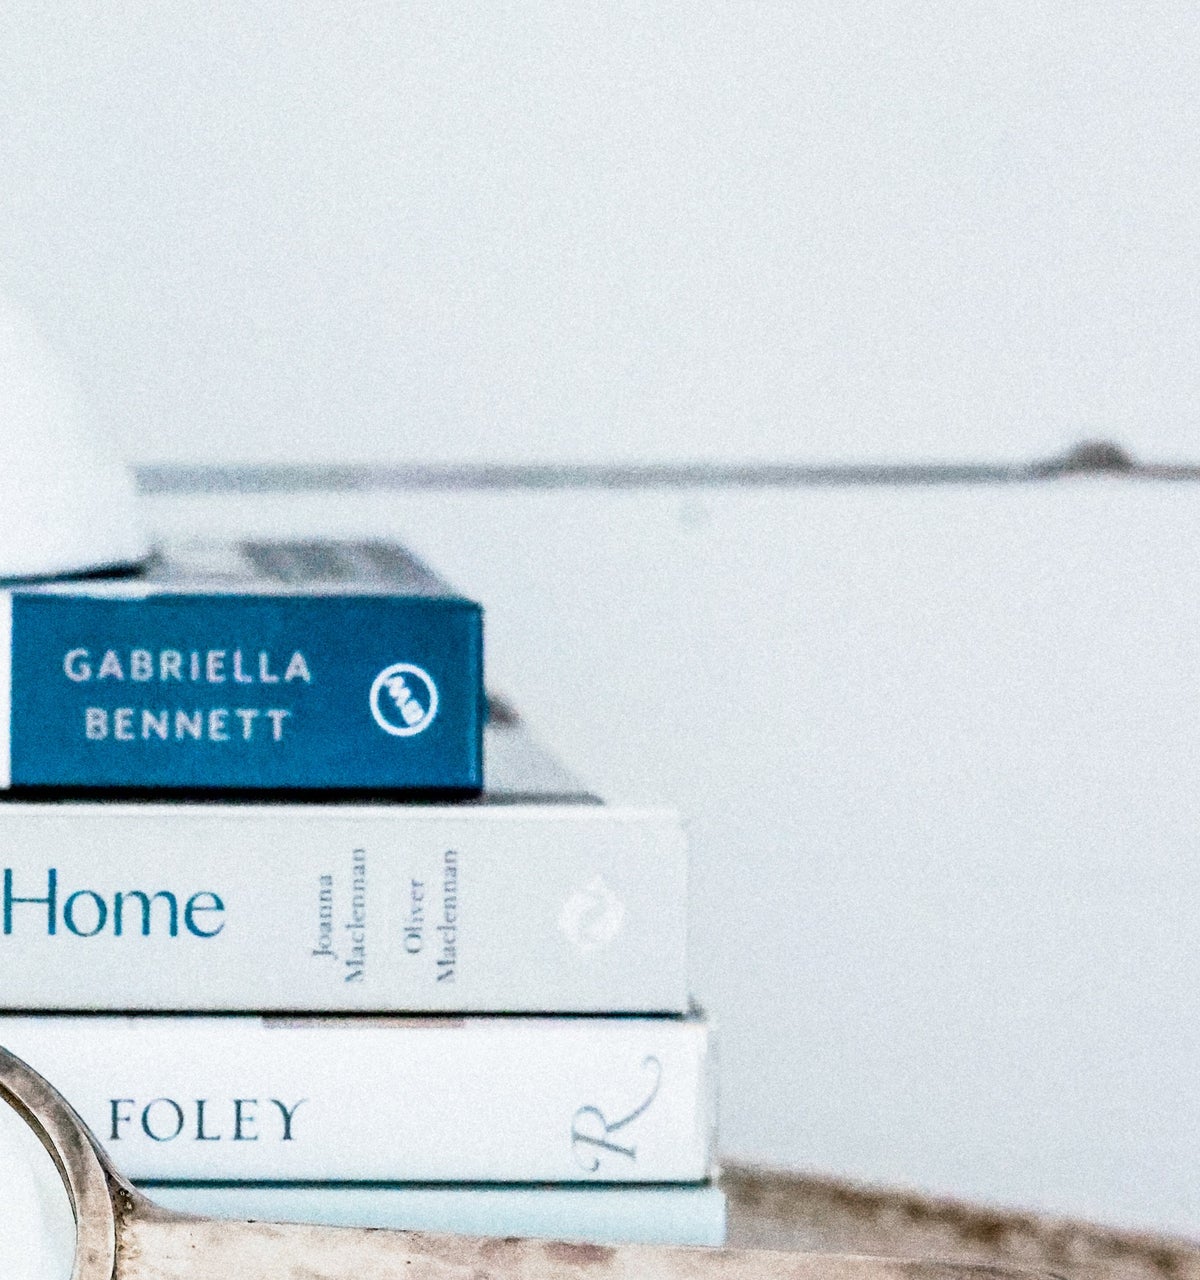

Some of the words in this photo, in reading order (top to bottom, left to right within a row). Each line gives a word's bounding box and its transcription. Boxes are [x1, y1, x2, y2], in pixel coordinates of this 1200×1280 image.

[63, 648, 312, 684] GABRIELLA
[85, 707, 291, 742] BENNETT
[2, 867, 226, 939] Home
[312, 875, 338, 960] Joanna
[345, 848, 366, 983] Maclennan
[403, 879, 424, 956] Oliver
[436, 849, 458, 983] Maclennan
[109, 1097, 307, 1143] FOLEY
